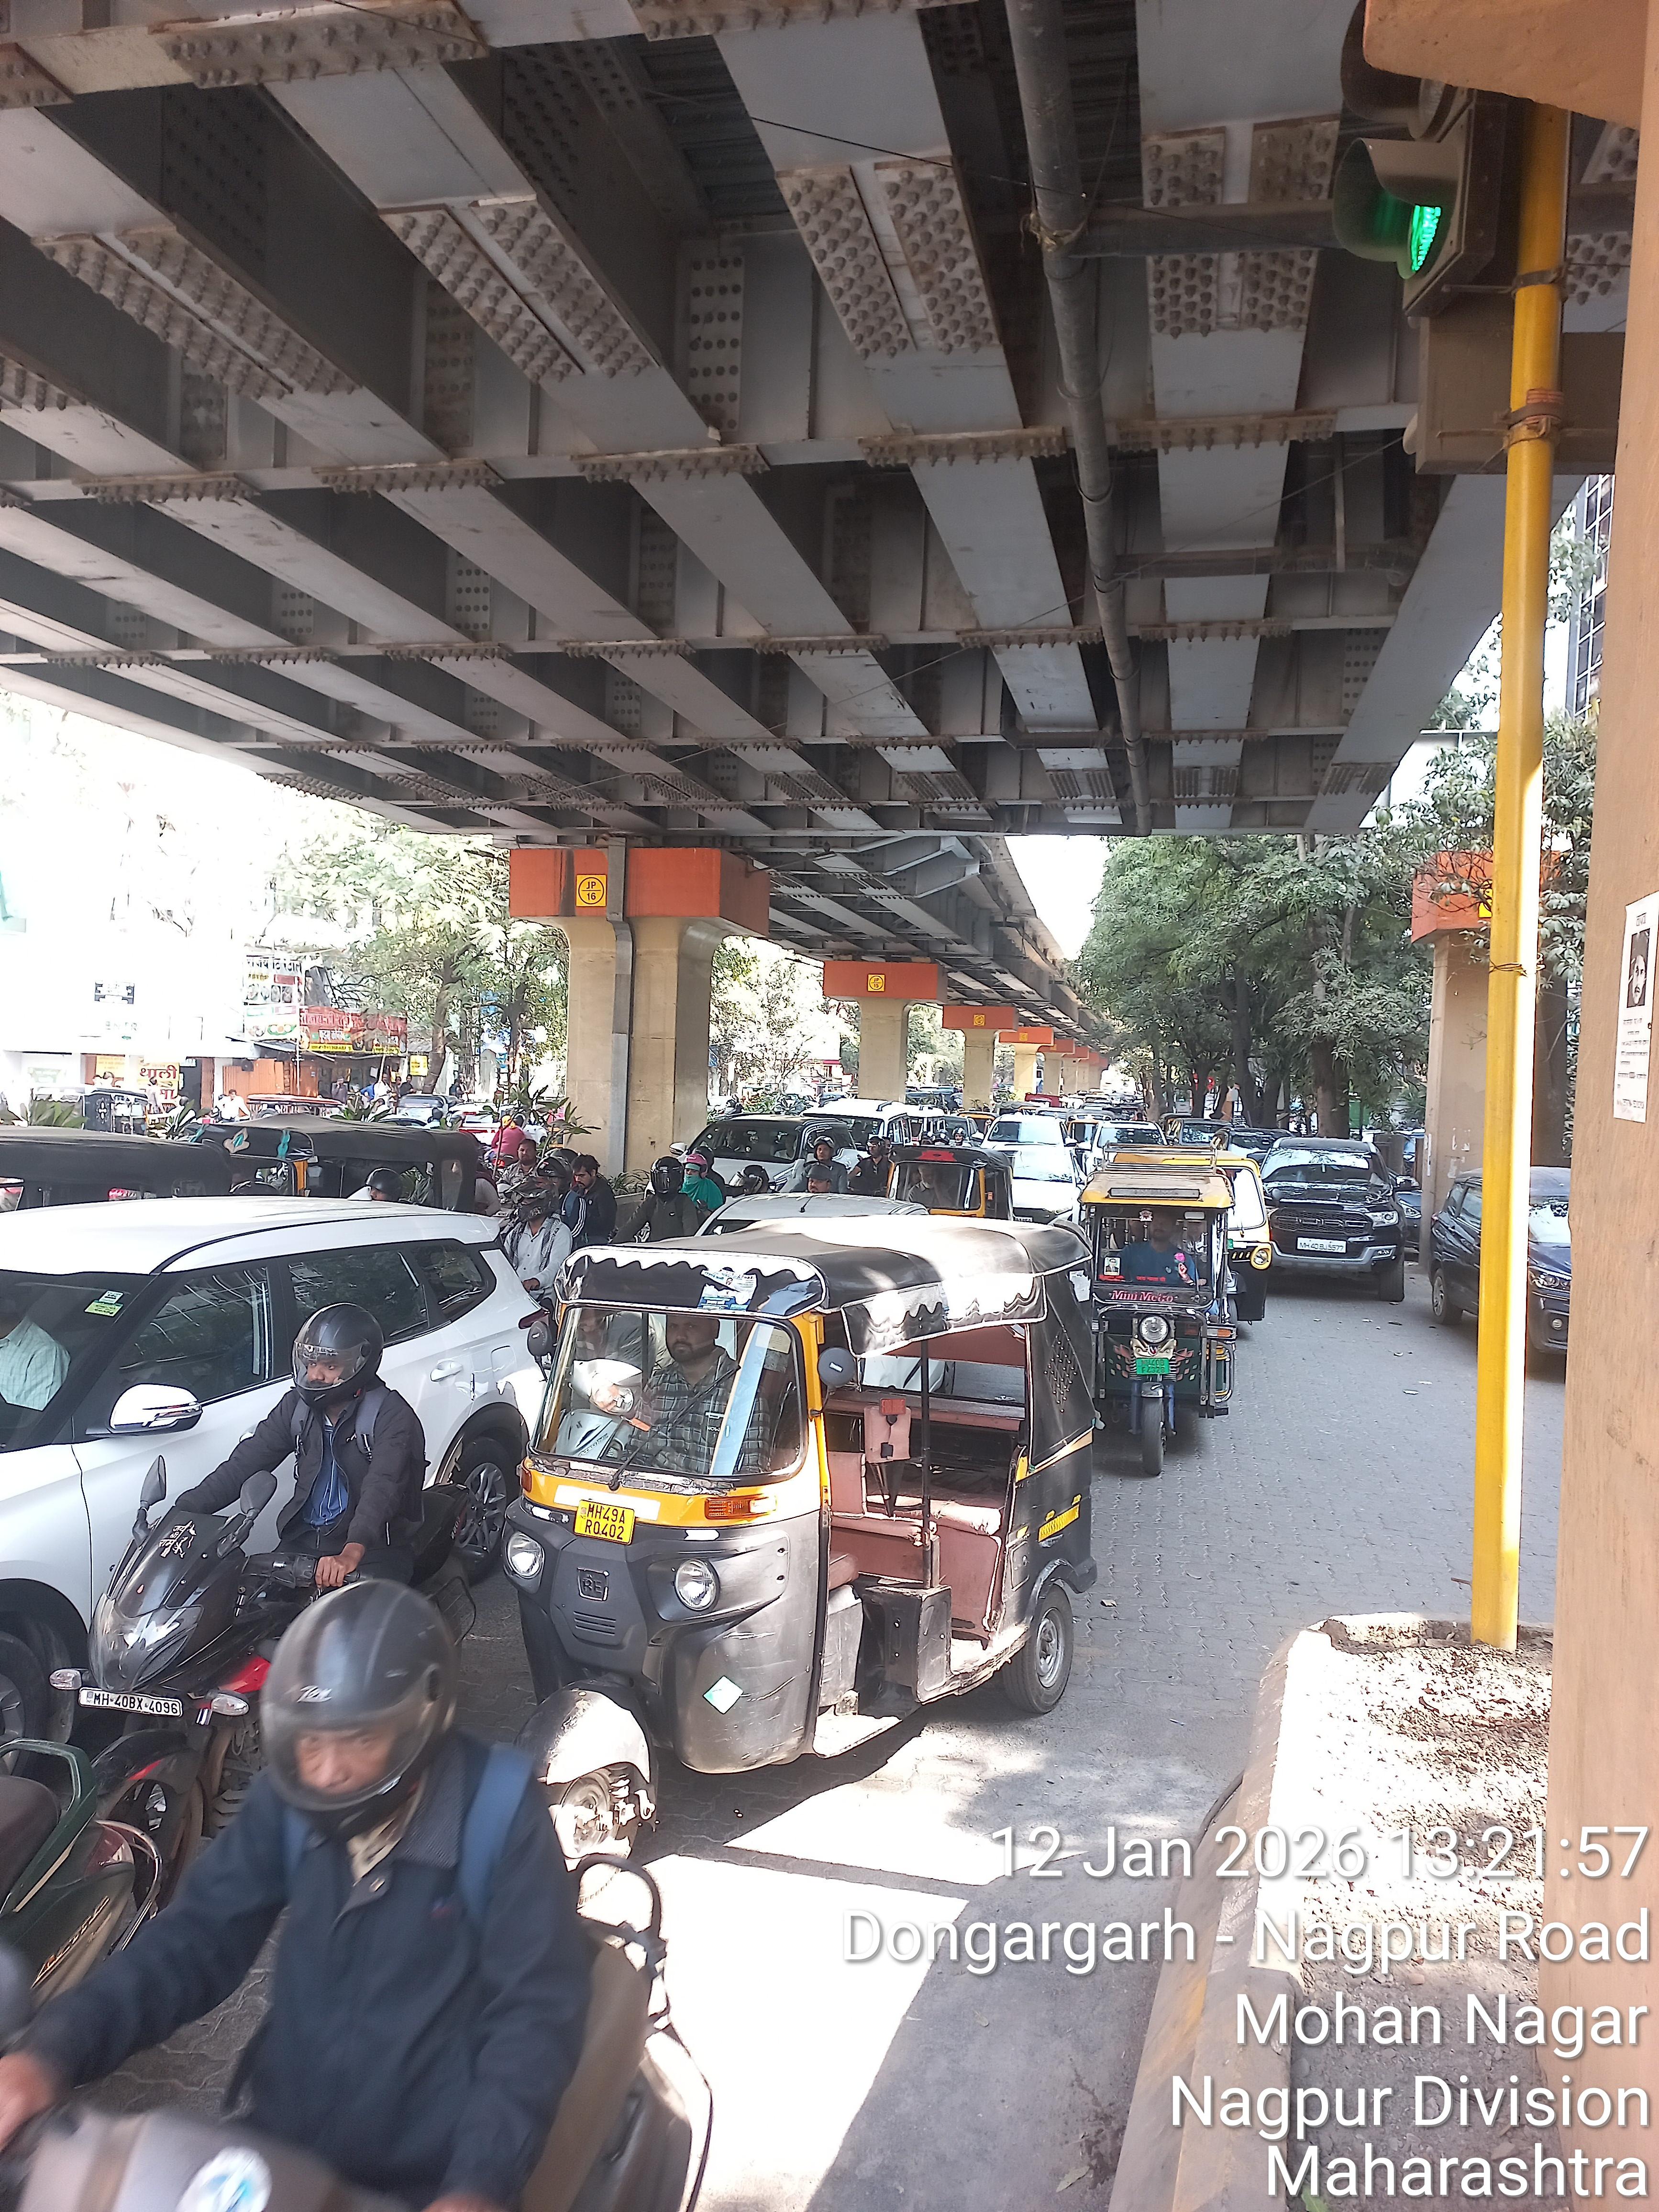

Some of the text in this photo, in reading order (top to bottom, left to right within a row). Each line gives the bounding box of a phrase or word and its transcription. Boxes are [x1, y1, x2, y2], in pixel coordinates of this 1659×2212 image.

[140, 1065, 177, 1079] थाली
[1111, 1290, 1173, 1303] Mini Metro
[587, 1504, 625, 1524] MH49A
